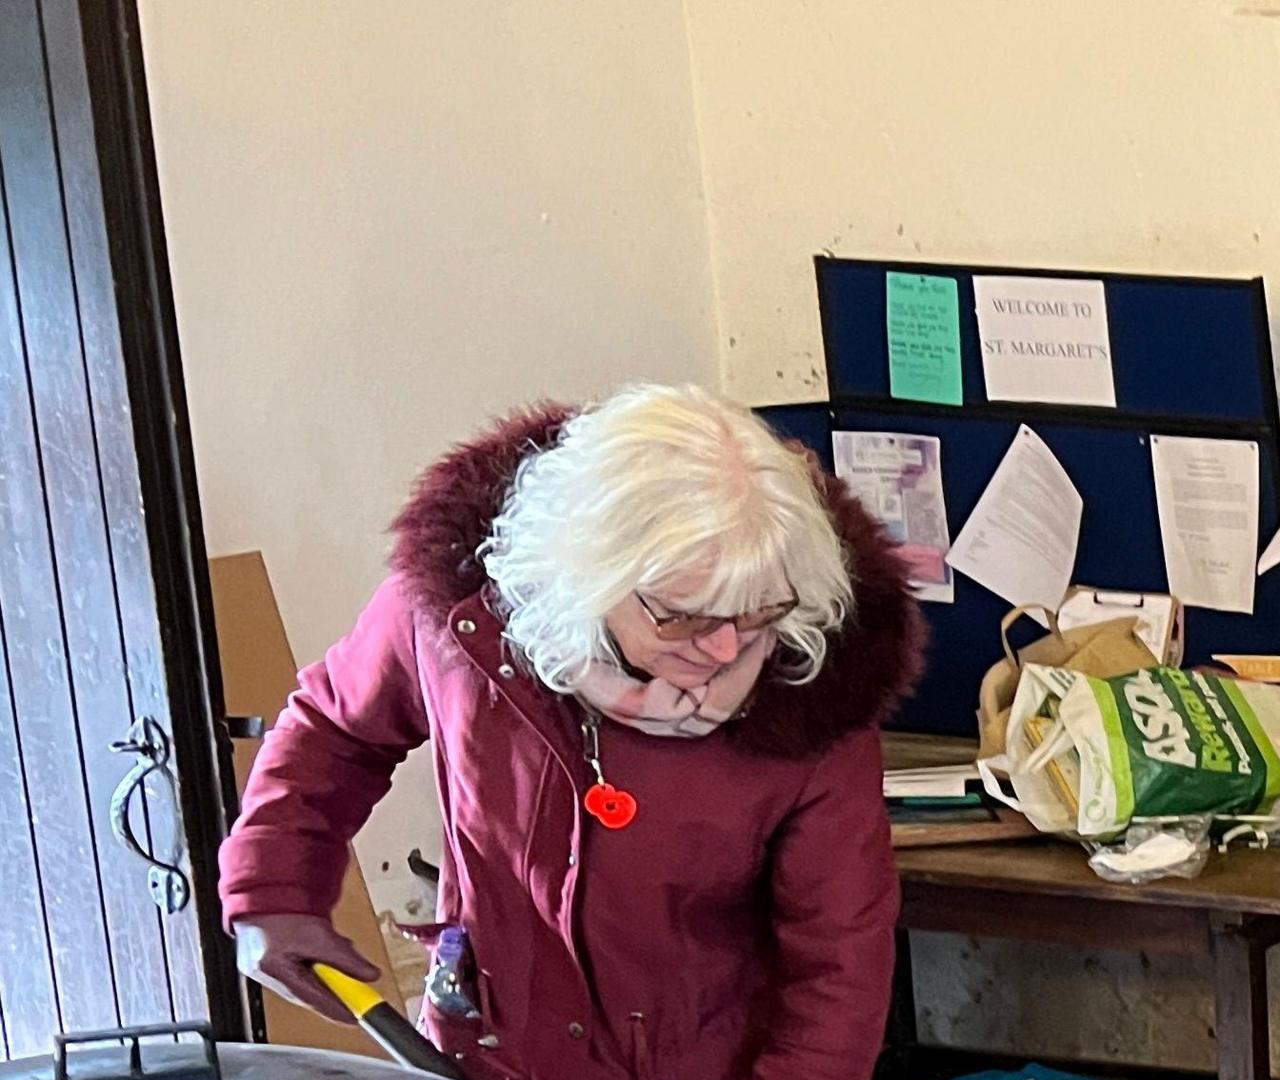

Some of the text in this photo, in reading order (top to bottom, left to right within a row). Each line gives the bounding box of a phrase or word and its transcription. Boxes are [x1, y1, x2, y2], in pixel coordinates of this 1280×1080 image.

[992, 298, 1092, 318] WELCOME TO
[1010, 340, 1108, 360] MARGARET'S
